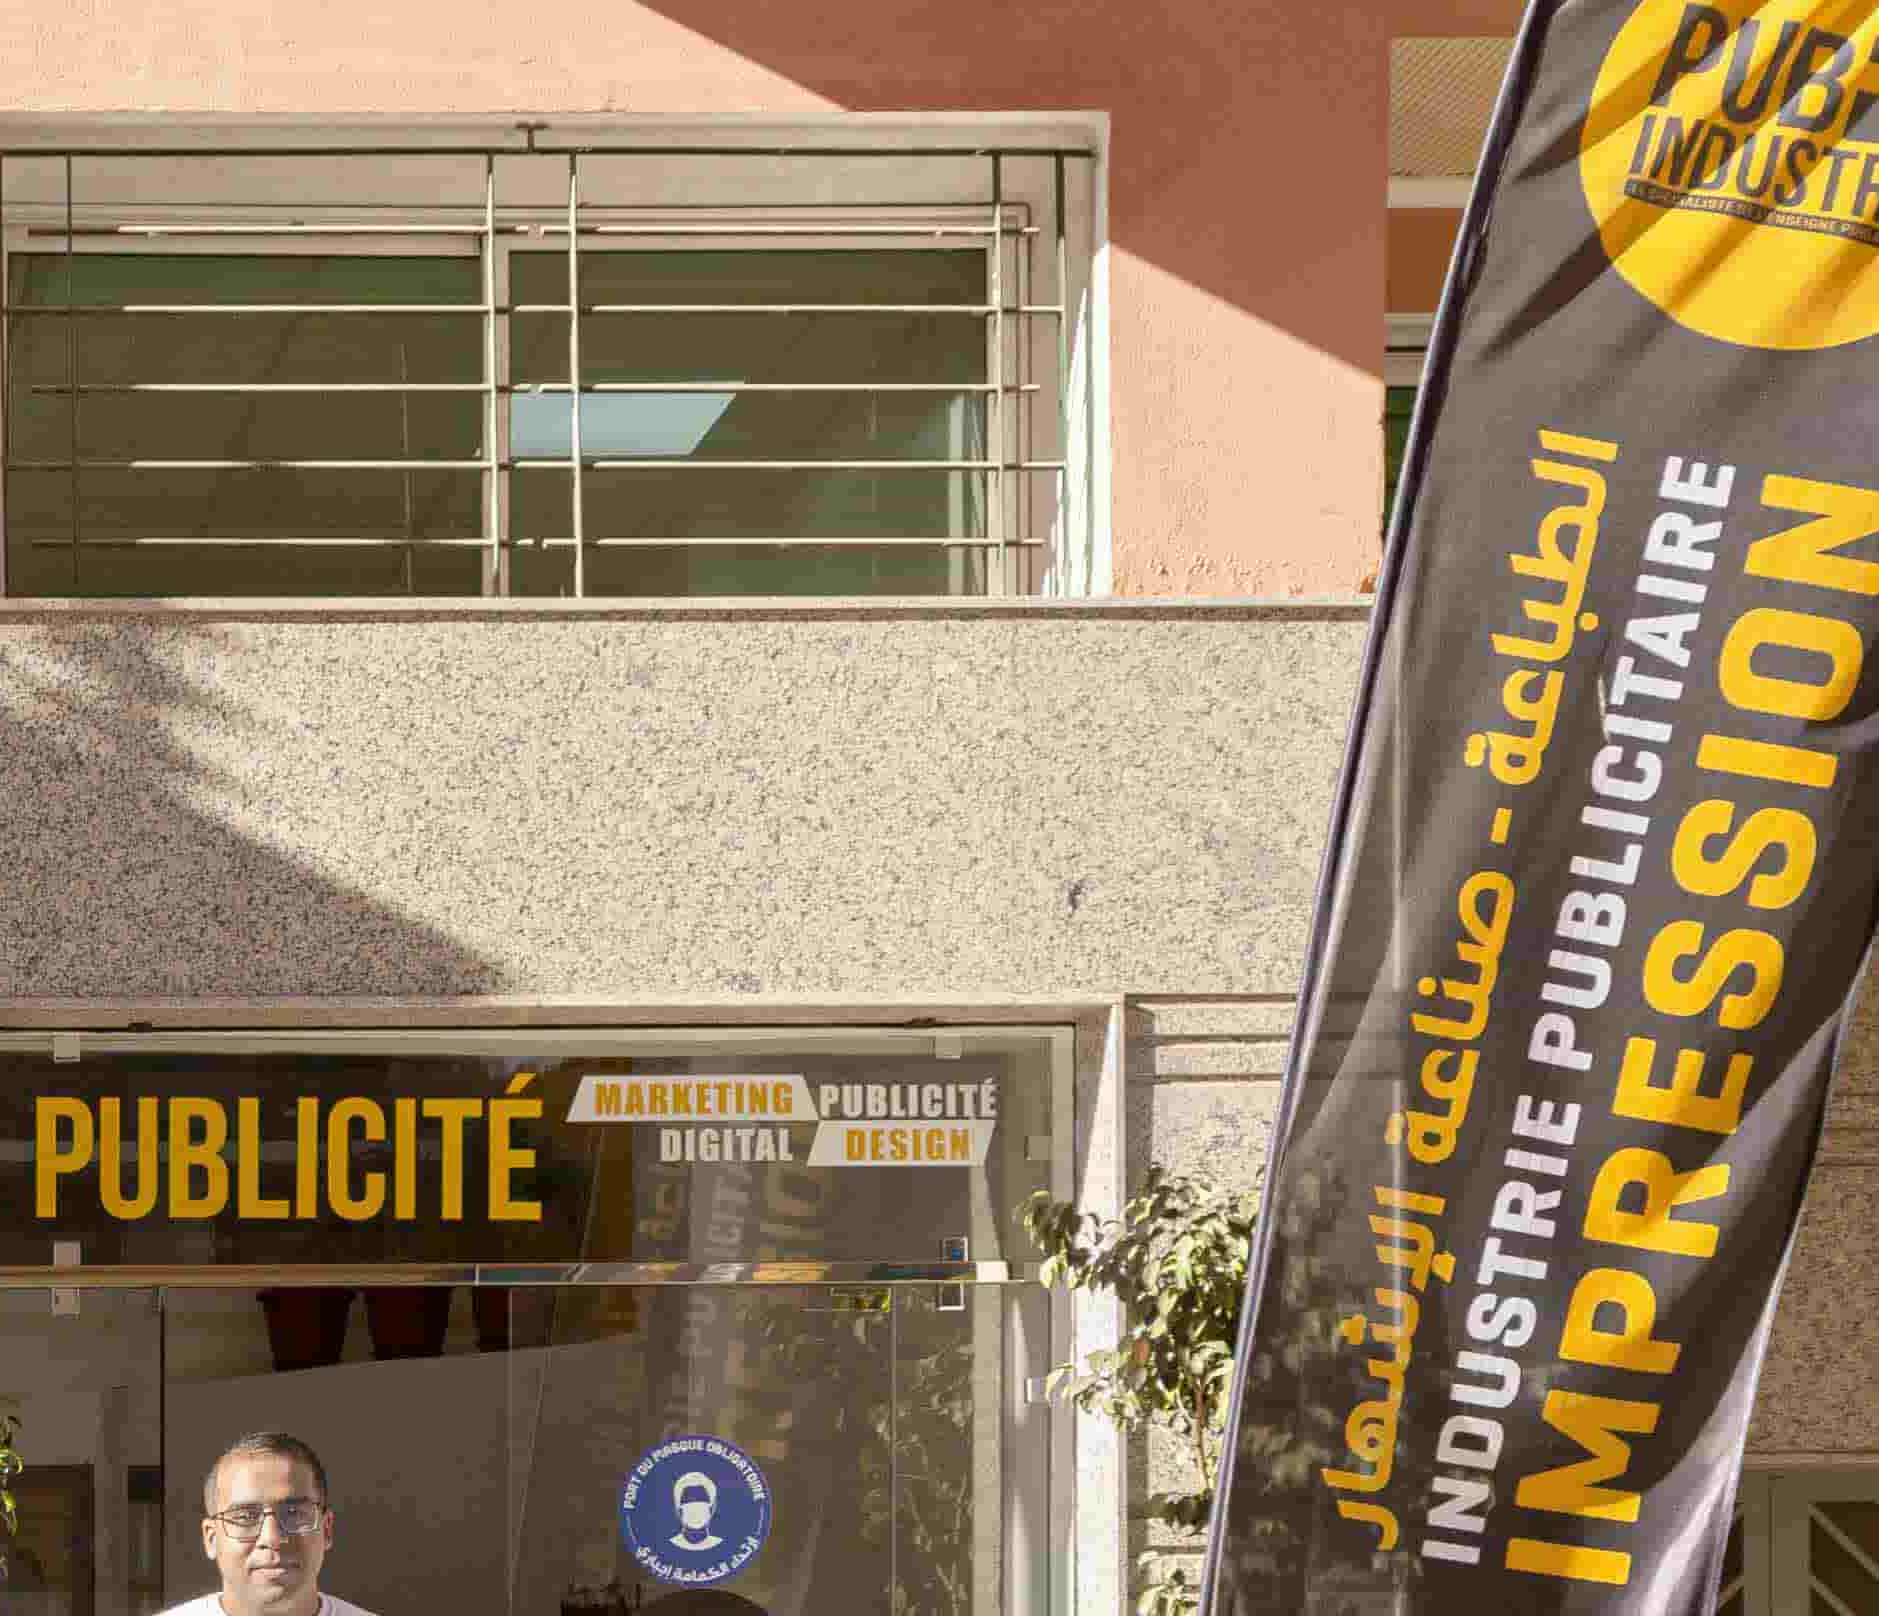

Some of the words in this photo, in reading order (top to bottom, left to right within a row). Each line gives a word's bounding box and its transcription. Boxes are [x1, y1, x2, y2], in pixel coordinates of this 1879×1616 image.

[1464, 429, 1619, 785] الطباعة
[34, 1076, 543, 1223] PUBLICITÉ
[593, 1081, 793, 1118] MARKETING
[820, 1078, 998, 1119] PUBLICITÉ
[660, 1128, 793, 1162] DIGITAL
[845, 1127, 970, 1161] DESIGN
[1385, 870, 1515, 1164] صناعة
[1421, 1095, 1582, 1565] INDUSTRIE
[1527, 455, 1737, 1071] PUBLICITAIRE
[1505, 474, 1879, 1586] IMPRESSION
[1322, 1185, 1456, 1551] الإشهار
